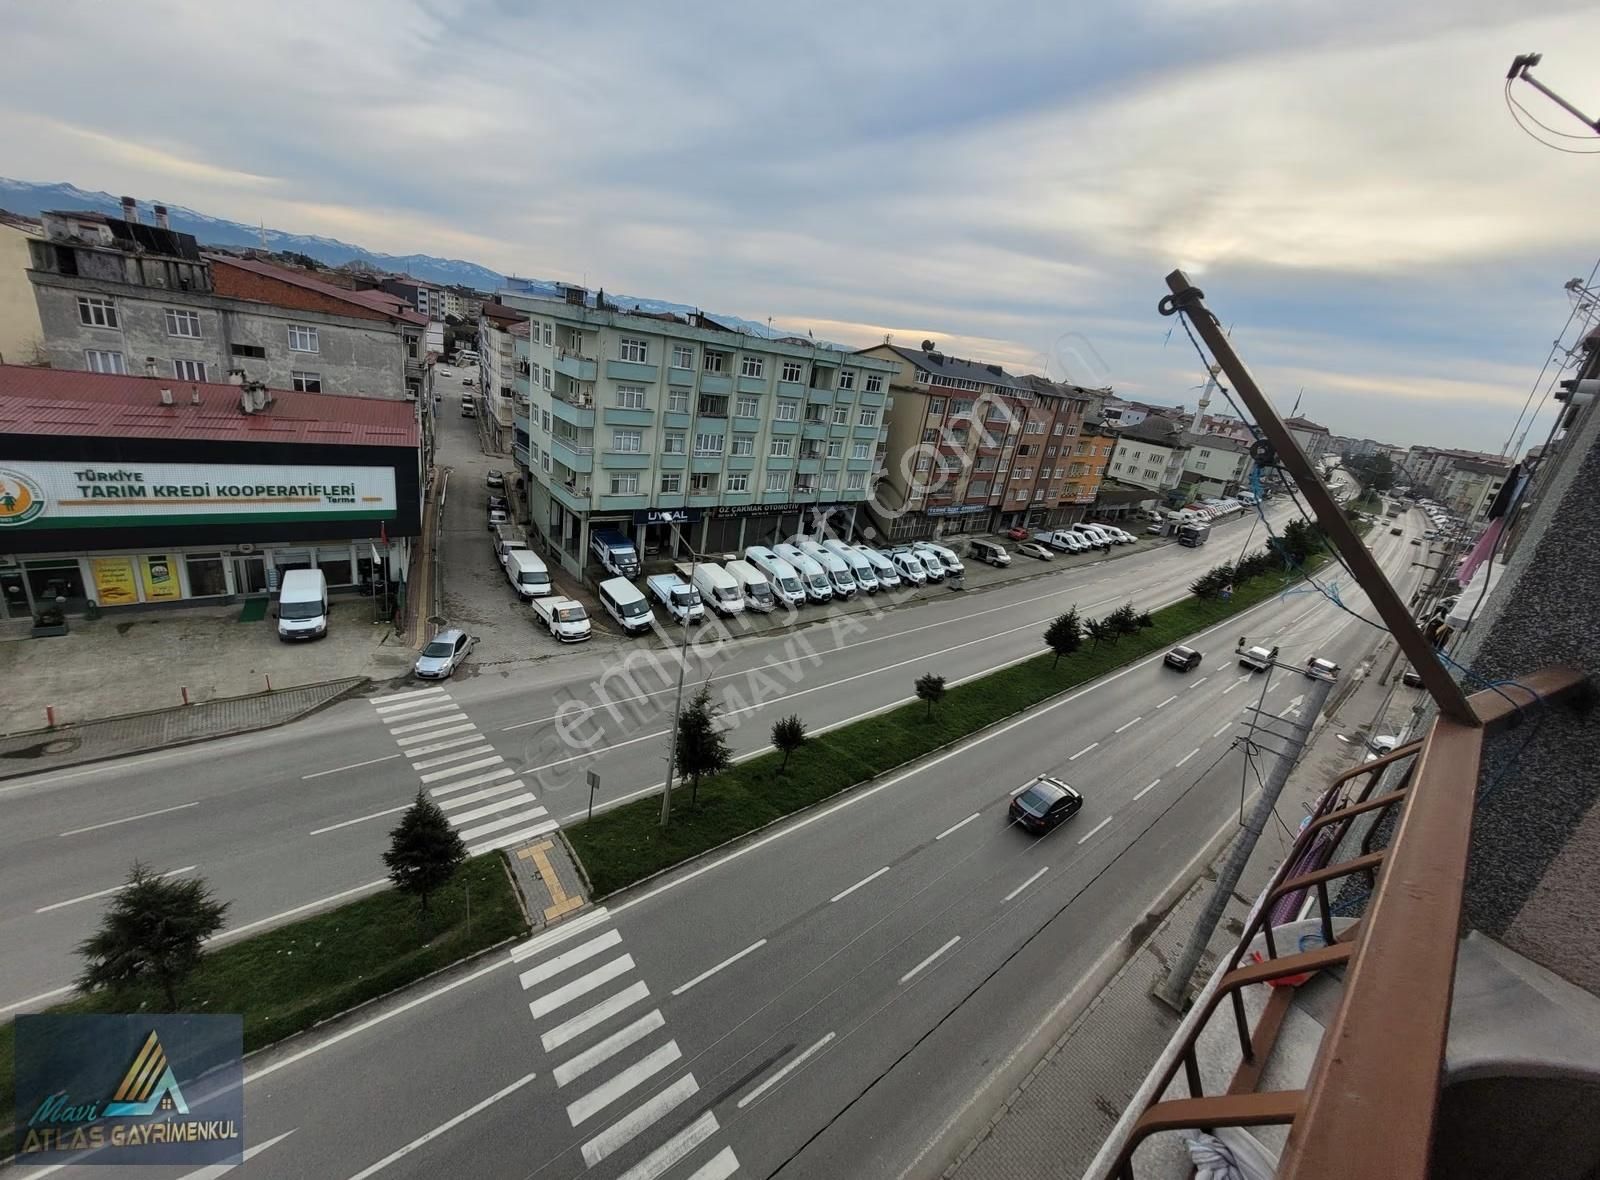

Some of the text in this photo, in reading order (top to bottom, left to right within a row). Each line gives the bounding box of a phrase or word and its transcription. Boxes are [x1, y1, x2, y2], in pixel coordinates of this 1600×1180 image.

[74, 469, 145, 482] TÜRKİYE
[77, 481, 356, 499] TARIM KREDİ KOOPERATİFLERİ
[326, 496, 356, 504] Terme
[648, 510, 688, 521] UYAL
